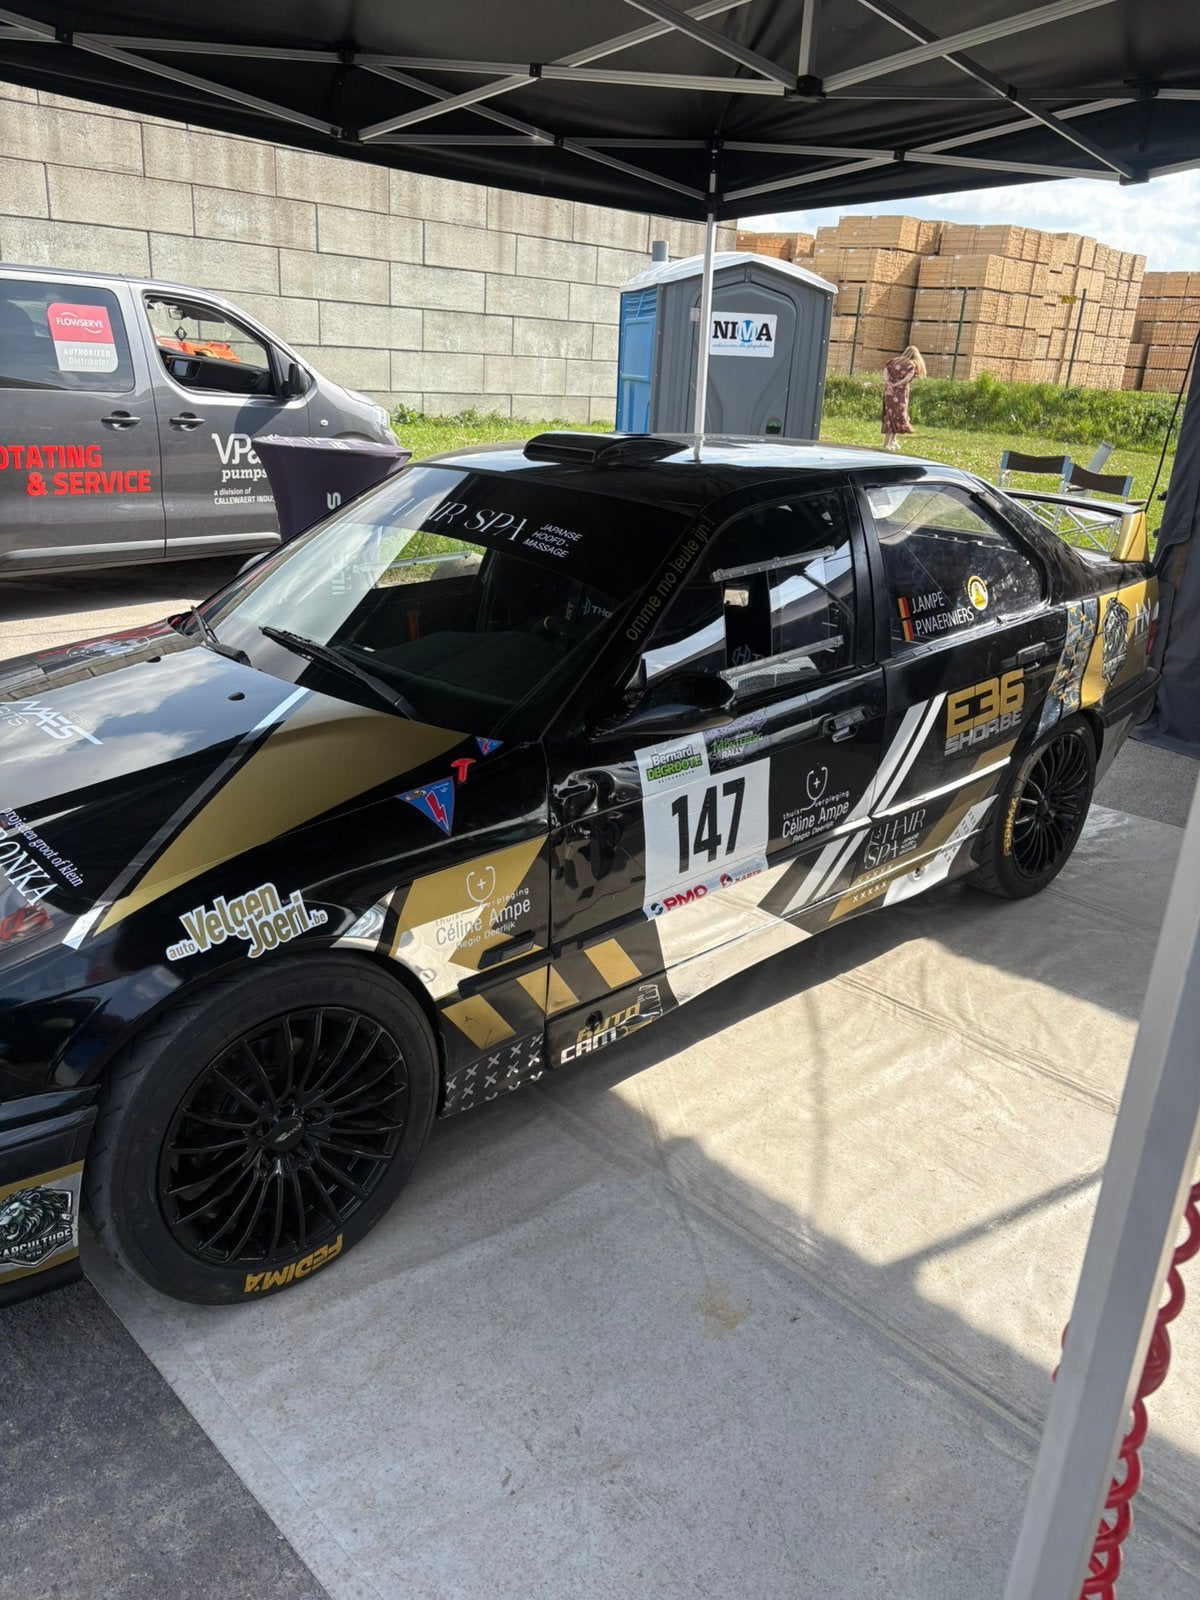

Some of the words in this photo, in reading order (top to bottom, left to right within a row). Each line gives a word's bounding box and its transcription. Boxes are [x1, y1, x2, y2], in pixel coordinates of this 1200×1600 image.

[56, 317, 104, 328] FLOWSERVE
[712, 320, 773, 343] NIMA
[63, 347, 111, 358] AUTHORIZED
[69, 357, 109, 367] Distributor
[27, 471, 48, 496] &
[53, 470, 152, 495] SERVICE
[222, 468, 268, 482] pumps
[214, 496, 256, 505] CALLEWAERT
[219, 487, 244, 496] division
[244, 487, 252, 495] of
[463, 508, 529, 542] SPA
[540, 524, 583, 543] JAPANSE
[523, 538, 570, 559] MASSAGE
[625, 595, 661, 641] omme
[656, 572, 677, 598] mo
[668, 539, 699, 574] leute
[912, 591, 945, 614] J.AMPE
[915, 606, 975, 637] P.WAERNIERS
[946, 667, 1025, 739] E36
[650, 744, 695, 768] Bernard
[721, 745, 745, 760] RALLY
[646, 754, 703, 781] DEGROOTE
[783, 809, 800, 820] thuis
[814, 790, 850, 807] verpleging
[671, 777, 746, 874] 147
[782, 815, 815, 839] Céline
[817, 801, 850, 824] Ampe
[881, 808, 926, 844] HAIR
[28, 838, 58, 860] groot
[52, 856, 71, 869] of
[59, 862, 84, 887] klein
[662, 884, 709, 911] PMO
[180, 883, 281, 952] Velgen
[436, 917, 483, 946] Céline
[488, 898, 531, 926] Ampe
[168, 940, 196, 959] auto
[0, 1228, 73, 1260] ARCULTURE
[243, 1232, 344, 1293] FEDIMA
